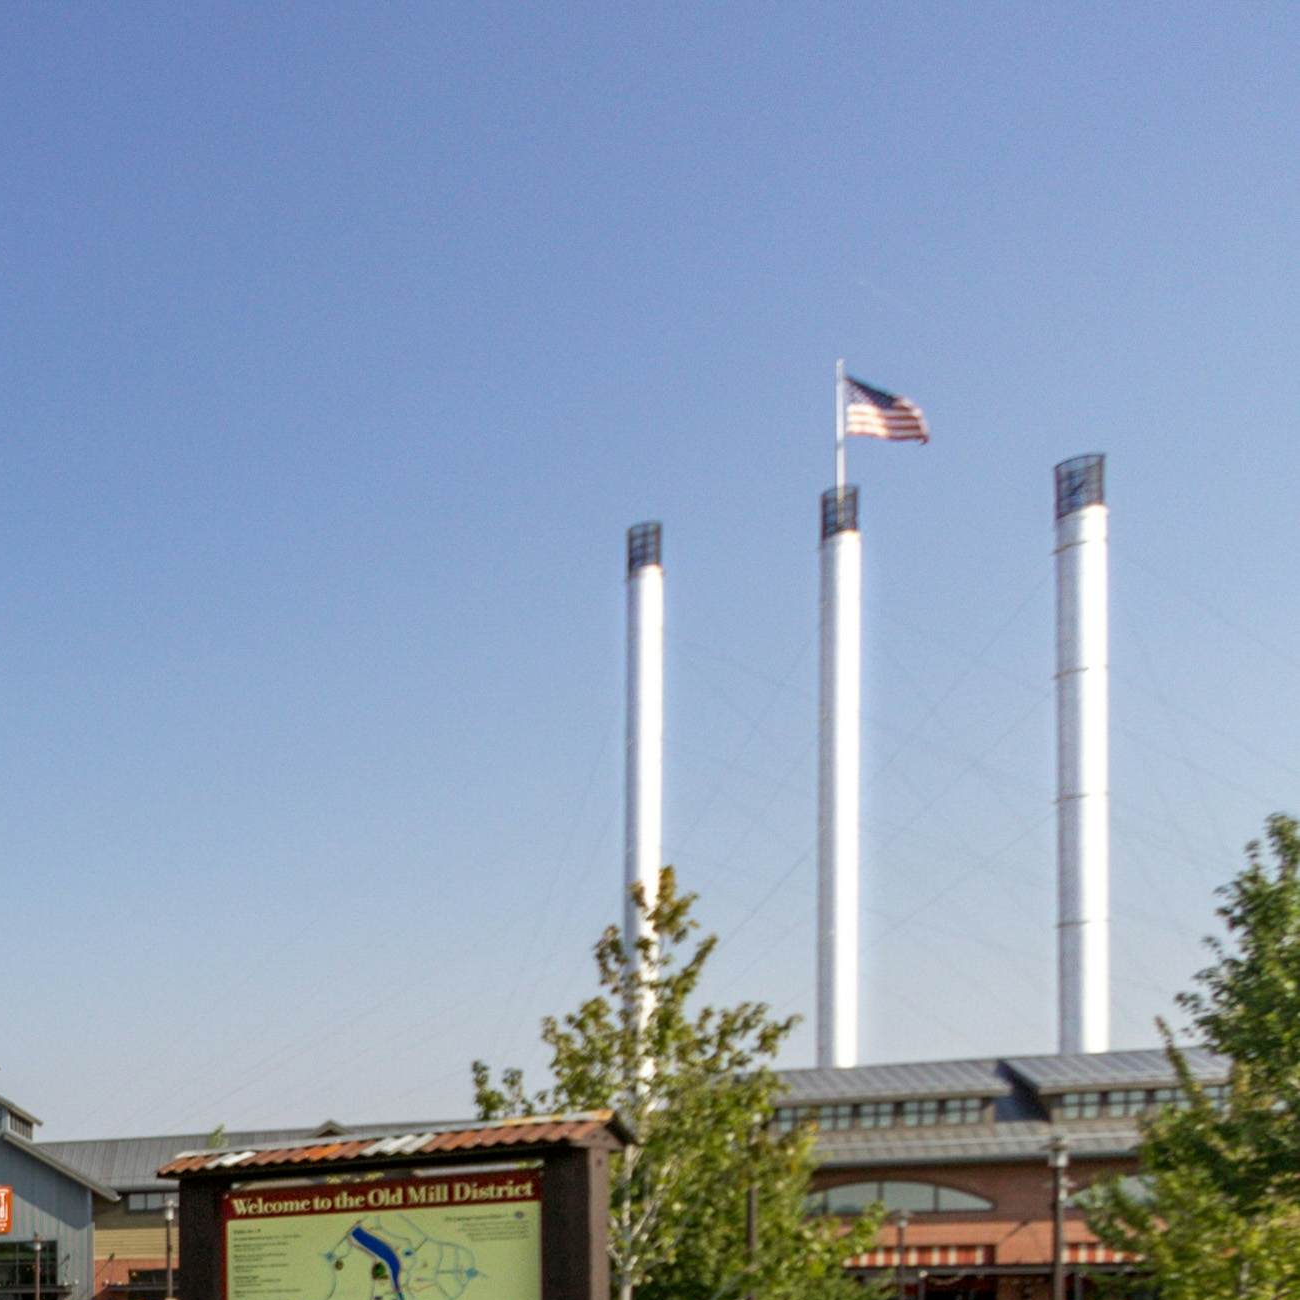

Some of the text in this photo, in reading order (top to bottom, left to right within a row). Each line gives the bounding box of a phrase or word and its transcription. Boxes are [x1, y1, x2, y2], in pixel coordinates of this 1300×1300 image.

[231, 1179, 533, 1216] Welcome to the Old Mill District
